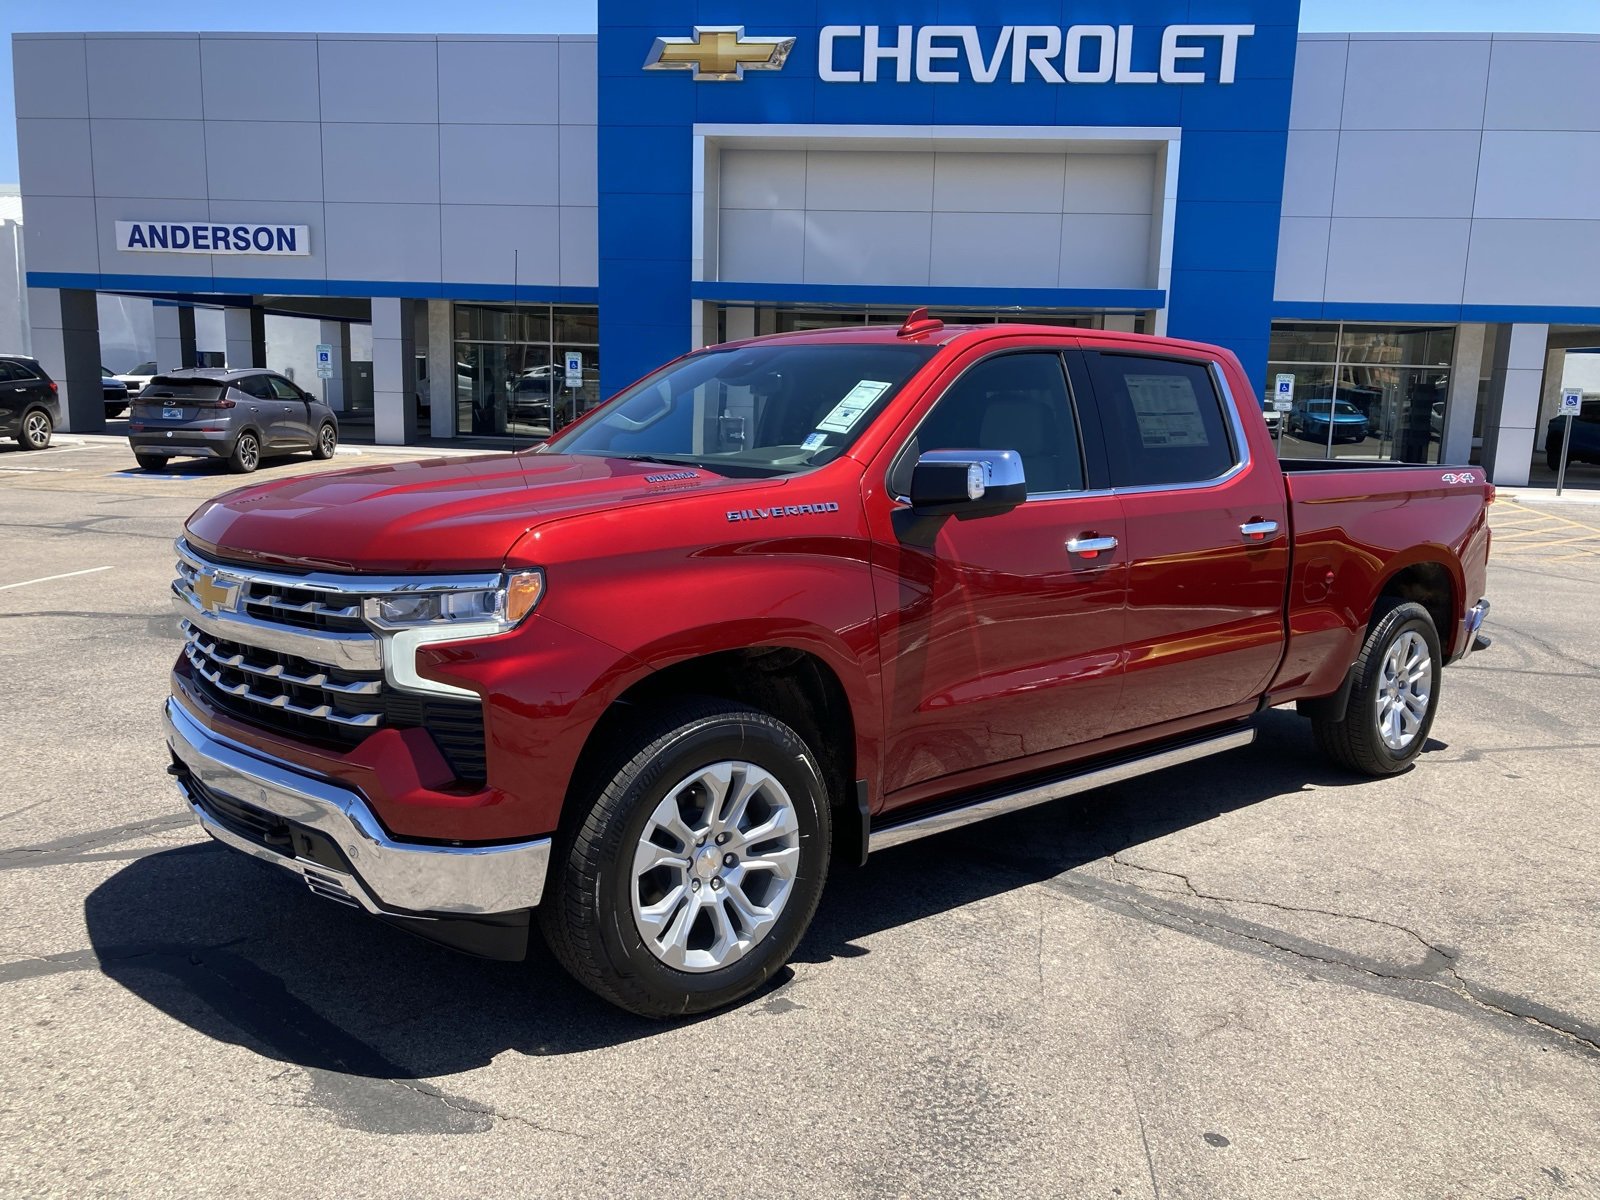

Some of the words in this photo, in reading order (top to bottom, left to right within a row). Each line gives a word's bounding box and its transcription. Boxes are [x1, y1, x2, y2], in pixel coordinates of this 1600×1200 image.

[818, 24, 1256, 84] CHEVROLET
[127, 224, 297, 252] ANDERSON
[644, 471, 700, 483] DURAMAX
[726, 502, 839, 522] SILVERADO
